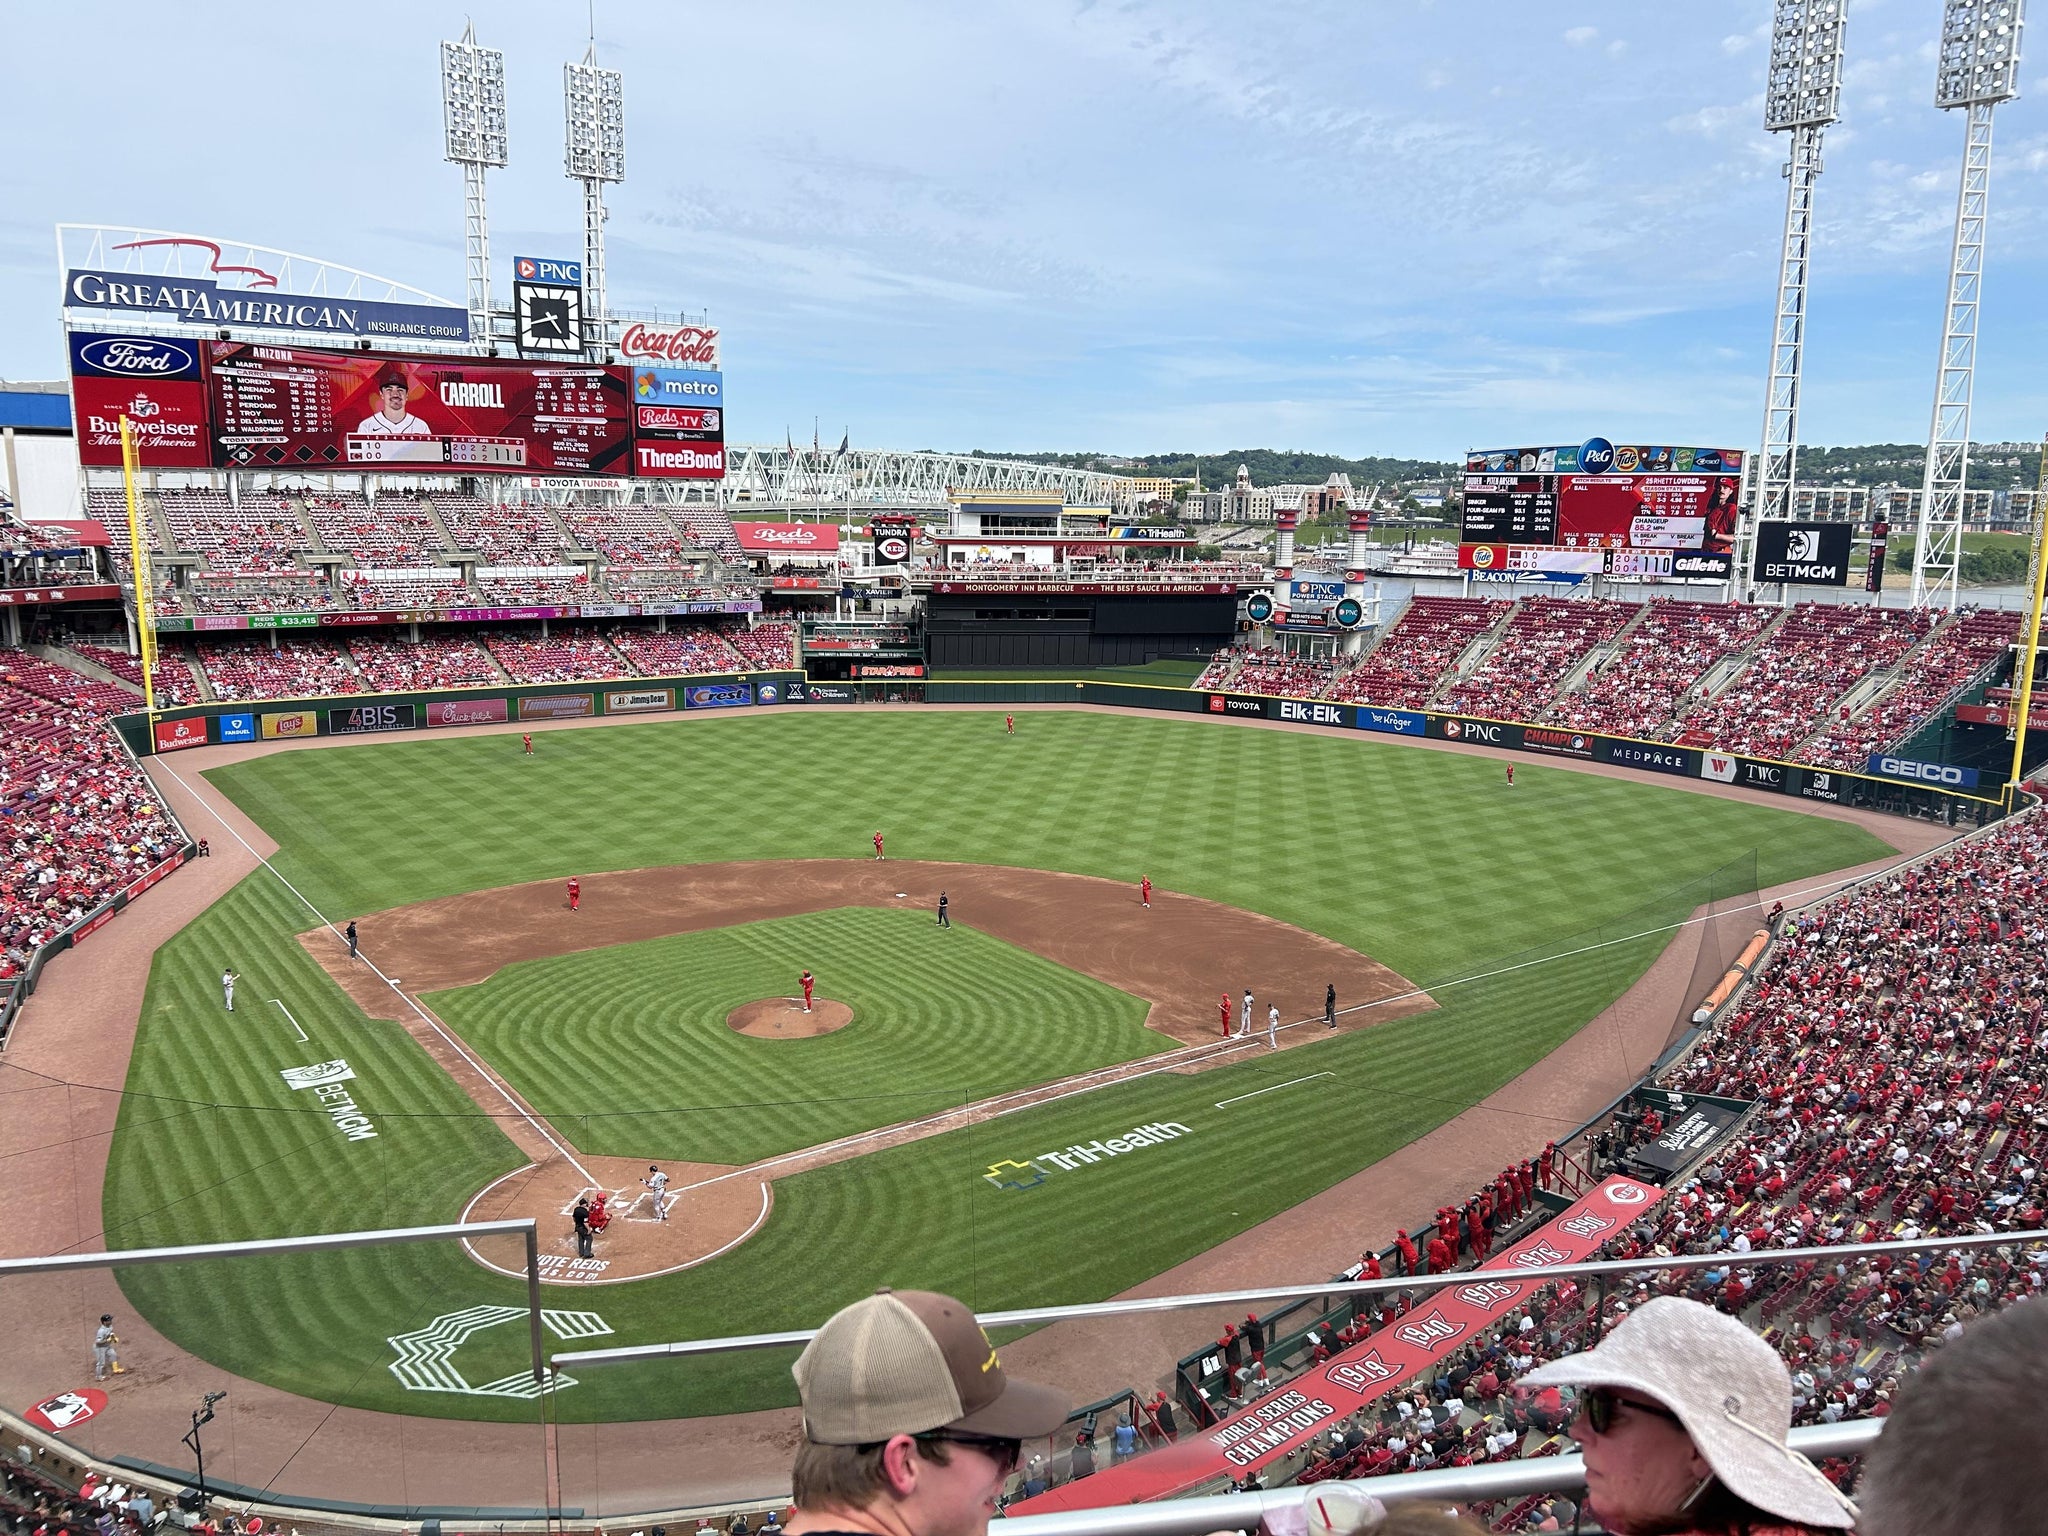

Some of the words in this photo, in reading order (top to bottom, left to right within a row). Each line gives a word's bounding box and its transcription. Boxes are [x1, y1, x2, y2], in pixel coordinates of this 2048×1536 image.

[538, 262, 580, 281] PNC
[72, 274, 195, 310] GREAT
[186, 293, 360, 332] AMERICAN
[368, 321, 427, 335] INSURANCE
[429, 325, 463, 337] GROUP
[620, 323, 719, 362] Coca-Cola
[102, 343, 172, 371] Ford
[253, 346, 293, 361] ARIZONA
[236, 361, 263, 369] MARTE
[237, 377, 271, 385] MORENO
[665, 380, 719, 396] metro
[238, 385, 275, 394] ARENADO
[238, 393, 263, 401] SMITH
[440, 382, 505, 408] CARROLL
[638, 448, 723, 469] ThreeBond
[1585, 449, 1611, 463] P&G
[1616, 451, 1638, 467] Tide
[543, 479, 580, 488] TOYOTA
[582, 479, 620, 488] TUNDRA
[753, 528, 817, 542] Reds
[875, 528, 908, 536] TUNDRA
[1147, 528, 1185, 539] TriHealth
[886, 544, 907, 553] REDS
[1565, 537, 1577, 546] 16
[1588, 538, 1600, 547] 23
[1610, 539, 1622, 547] 39
[1475, 551, 1492, 563] Tide
[1675, 558, 1727, 573] Gillette
[1765, 563, 1836, 580] BETMGM
[1472, 570, 1517, 583] BEACON
[965, 584, 1019, 592] MONTGOMERY
[1021, 584, 1035, 592] INN
[1037, 584, 1075, 592] BARBECUE
[1100, 584, 1115, 592] THE
[1117, 584, 1135, 592] BEST
[1136, 584, 1161, 592] SAUCE
[1162, 584, 1171, 592] IN
[1172, 584, 1205, 592] AMERICA
[1311, 584, 1336, 595] PNC
[690, 604, 716, 612] WLWT
[733, 602, 754, 611] ROSE
[281, 616, 317, 625] $33,415
[629, 695, 650, 706] Jimmy
[650, 694, 665, 704] Dean
[694, 690, 743, 703] Crest
[1227, 701, 1260, 711] TOYOTA
[349, 705, 398, 726] 4BIS
[1383, 713, 1412, 730] Kroger
[279, 717, 303, 732] Lay's
[1464, 723, 1501, 742] PNC
[1524, 729, 1593, 749] CHAMPION
[159, 735, 206, 750] Budweiser
[1613, 748, 1683, 767] MEDPACE
[1745, 763, 1781, 783] TWC
[1880, 758, 1963, 785] GEICO
[1803, 787, 1838, 800] BETMGM
[314, 1083, 379, 1142] BETMGM
[1036, 1122, 1193, 1171] TriHealth
[1618, 1185, 1639, 1199] REDS
[1564, 1215, 1602, 1235] 1990
[567, 1258, 611, 1272] REDS
[1515, 1248, 1558, 1268] 1976
[1461, 1281, 1510, 1307] 1975
[1402, 1319, 1453, 1346] 1940
[1333, 1358, 1388, 1390] 1919
[1210, 1415, 1263, 1448] WORLD
[1256, 1389, 1307, 1422] SERIES
[1224, 1399, 1335, 1466] CHAMPIONS
